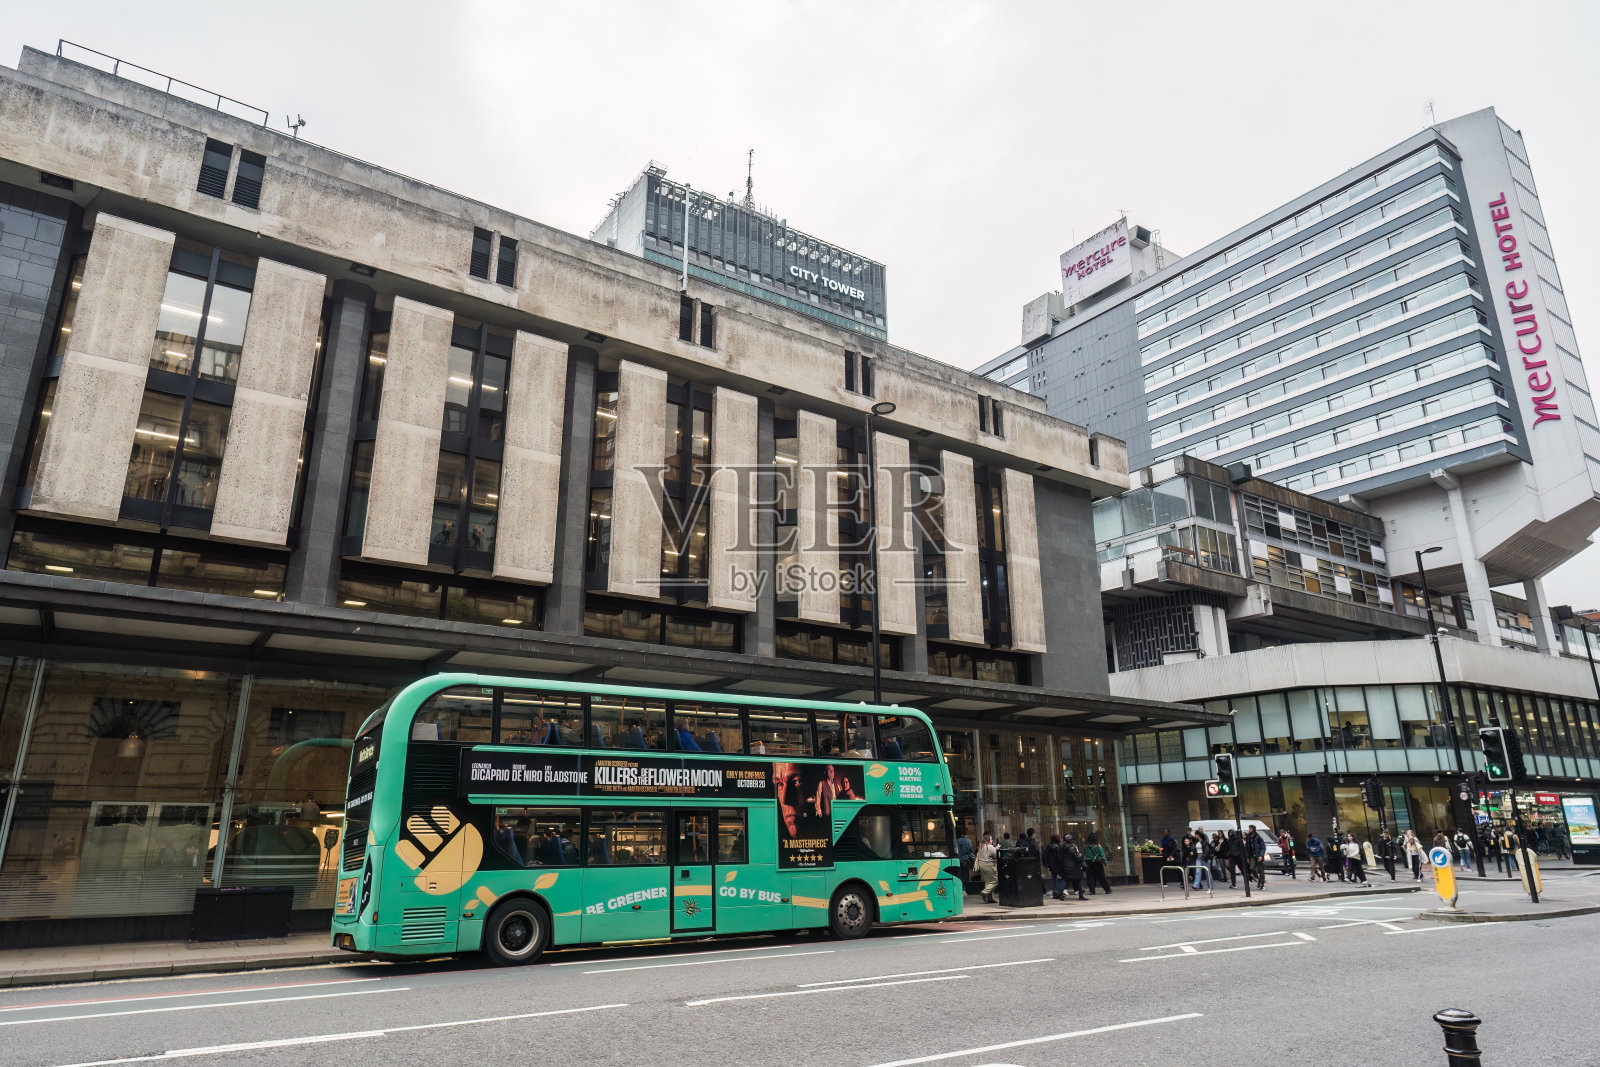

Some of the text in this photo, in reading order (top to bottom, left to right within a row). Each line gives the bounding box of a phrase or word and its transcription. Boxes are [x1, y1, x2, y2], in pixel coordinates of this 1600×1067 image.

[1063, 236, 1126, 277] mercure
[1077, 256, 1113, 280] HOTEL
[790, 265, 864, 301] CITY TOWER
[1489, 191, 1561, 429] mercure HOTEL
[471, 768, 588, 784] DiCAPRIO DE NIRO GLADSTONE
[594, 767, 722, 787] KILLERS OF THE FLOWER MOON
[726, 770, 765, 779] ONLY IN CINEMAS
[898, 767, 921, 776] 100%
[737, 780, 765, 788] OCTOBER 20
[900, 785, 922, 793] ZERO
[586, 887, 667, 914] BE GREENER
[719, 886, 781, 903] GO BY BUS
